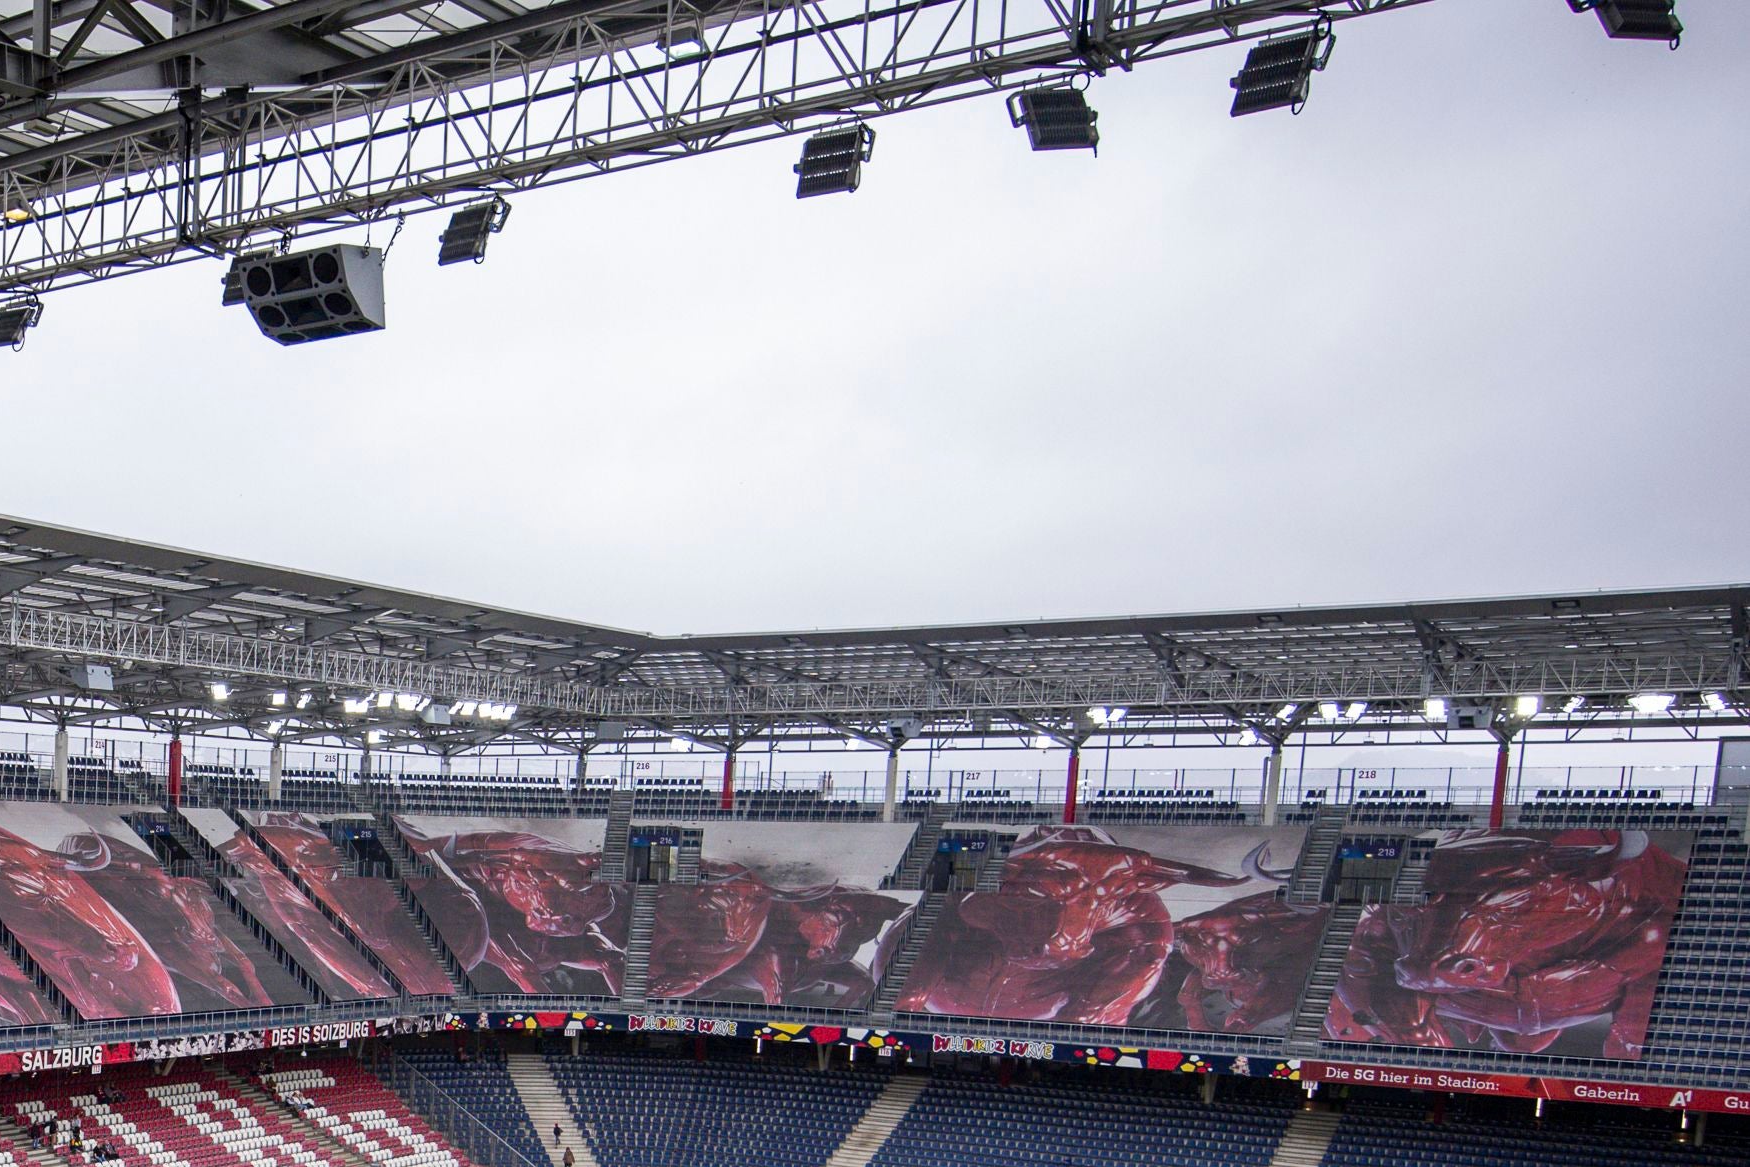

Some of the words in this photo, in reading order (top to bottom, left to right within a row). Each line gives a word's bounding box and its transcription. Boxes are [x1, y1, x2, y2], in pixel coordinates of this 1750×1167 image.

[324, 754, 336, 763] 215
[636, 762, 650, 770] 216
[966, 772, 980, 780] 217
[1358, 770, 1376, 779] 218
[155, 824, 166, 834] 214
[659, 836, 673, 845] 216
[971, 842, 986, 850] 217
[1377, 848, 1395, 857] 218
[698, 1019, 737, 1036] KURVE
[271, 1028, 295, 1047] DES
[298, 1026, 310, 1044] IS
[312, 1021, 369, 1043] SOIZBURG
[1010, 1040, 1054, 1059] KURVE
[22, 1046, 103, 1073] SALZBURG
[1325, 1066, 1349, 1080] Die
[1354, 1069, 1375, 1082] 5G
[1380, 1071, 1409, 1085] hier
[1414, 1073, 1433, 1087] im
[1438, 1074, 1499, 1091] Stadion:
[1670, 1090, 1692, 1107] A1
